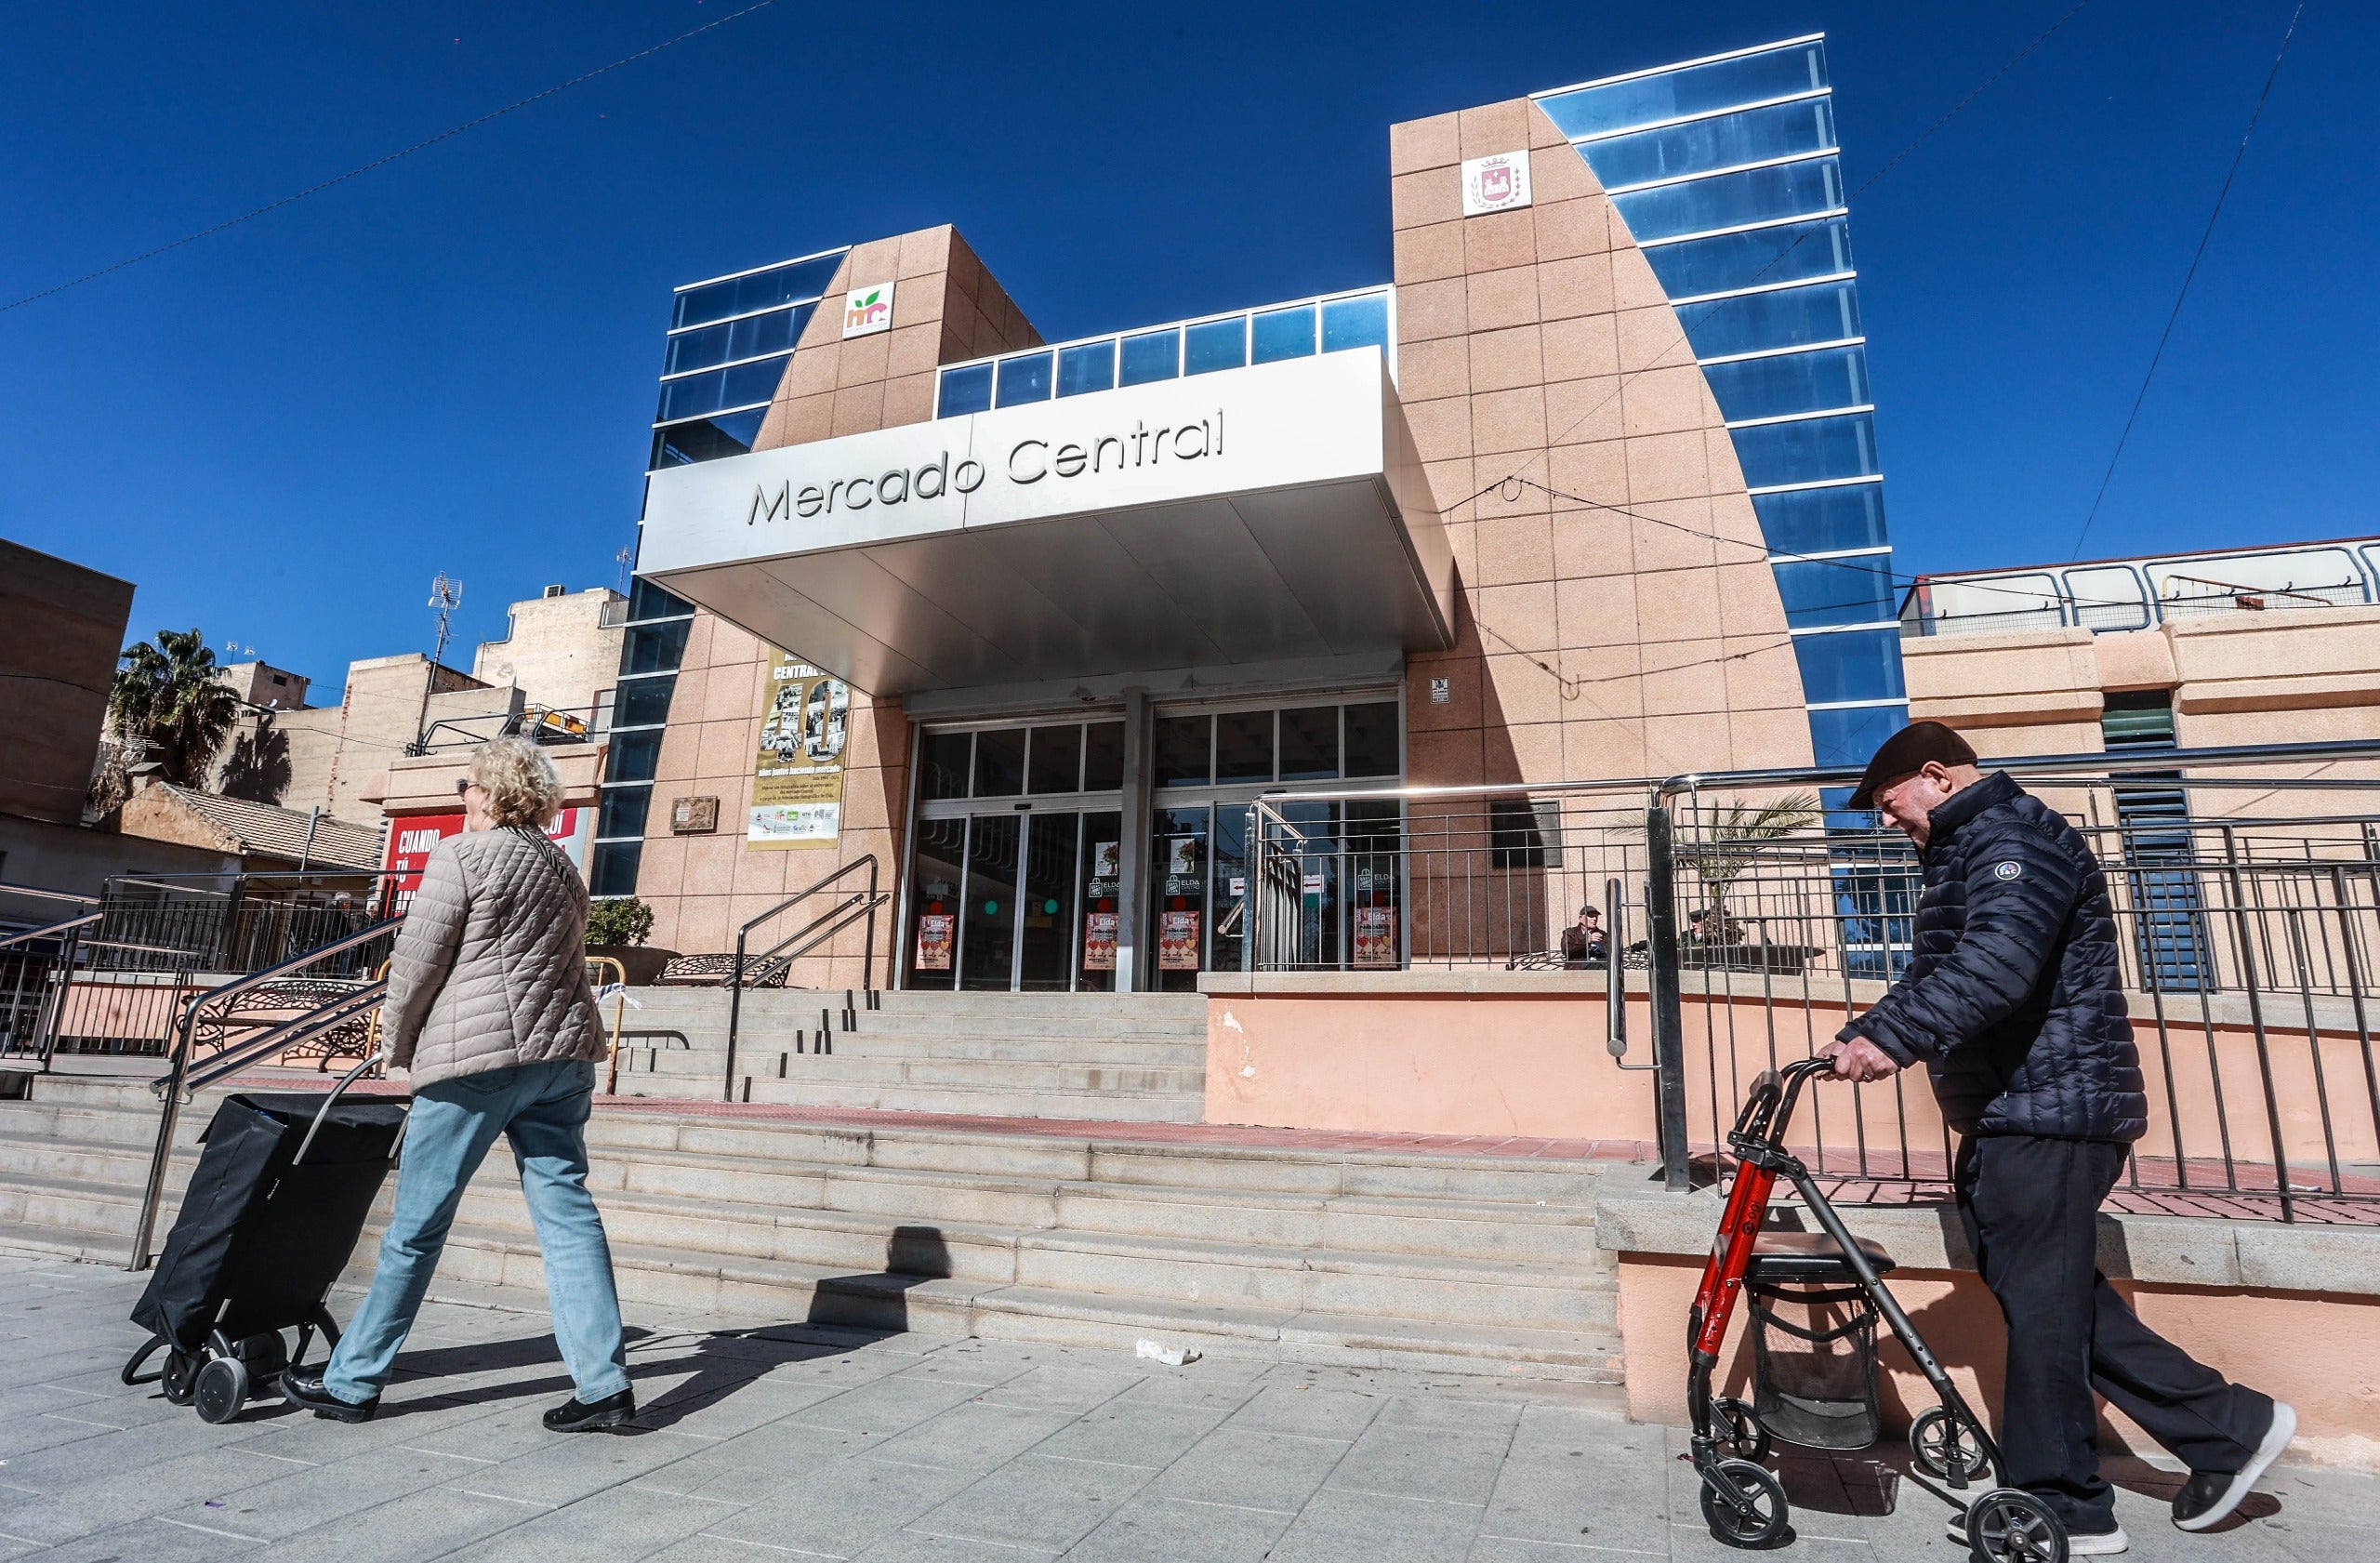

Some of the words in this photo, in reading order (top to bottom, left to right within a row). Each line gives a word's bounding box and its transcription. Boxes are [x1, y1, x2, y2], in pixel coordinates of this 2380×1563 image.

[747, 450, 985, 525] Mercado
[1008, 407, 1224, 485] Central
[774, 664, 818, 681] CENTRAL
[789, 765, 815, 775] haciendo
[814, 764, 840, 774] mercado
